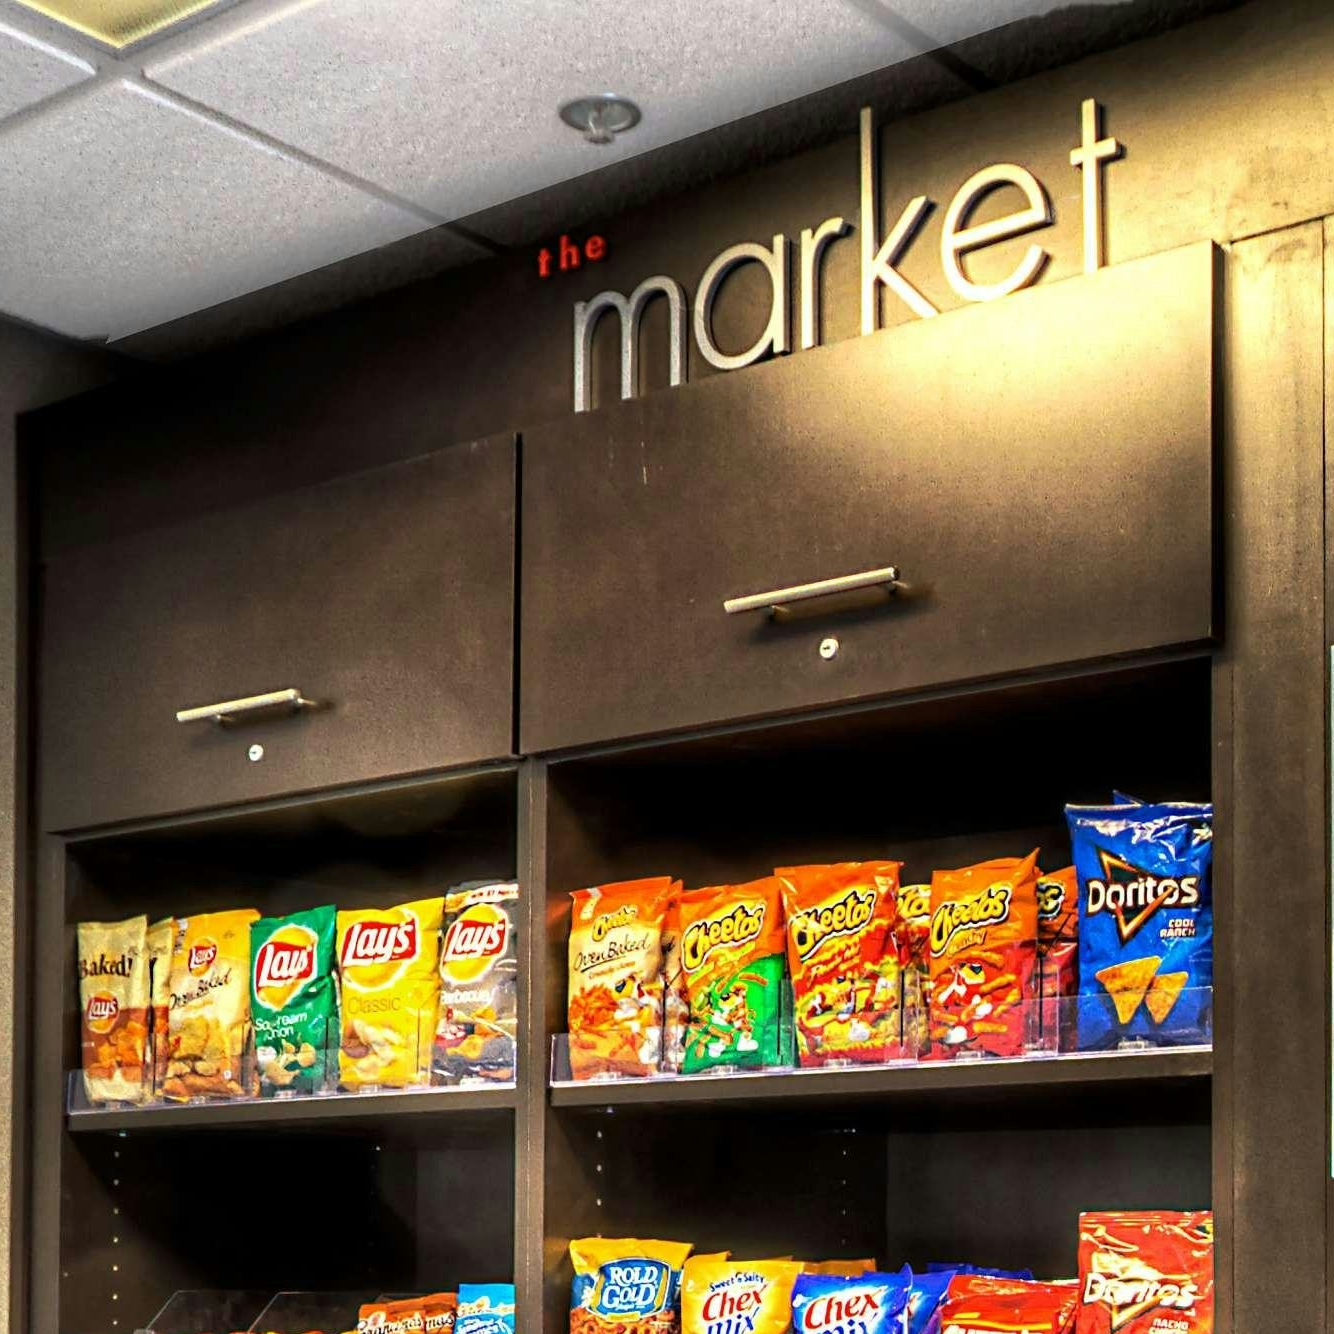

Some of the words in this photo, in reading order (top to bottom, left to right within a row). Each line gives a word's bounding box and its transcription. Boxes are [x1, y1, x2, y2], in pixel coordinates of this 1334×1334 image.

[537, 233, 606, 278] the
[573, 98, 1122, 413] market
[1087, 877, 1199, 915] Doritos
[683, 904, 764, 970] Cheetos
[791, 888, 875, 958] Cheetos
[931, 888, 1009, 957] Cheetos
[1160, 928, 1196, 938] RANCH
[1169, 918, 1195, 928] COOL
[80, 953, 134, 979] Baked!
[348, 996, 401, 1015] Classic
[609, 1265, 659, 1287] ROLD
[1083, 1271, 1198, 1309] Doritos
[602, 1282, 658, 1309] GOLD
[702, 1281, 769, 1322] Chex
[804, 1288, 883, 1330] Chex
